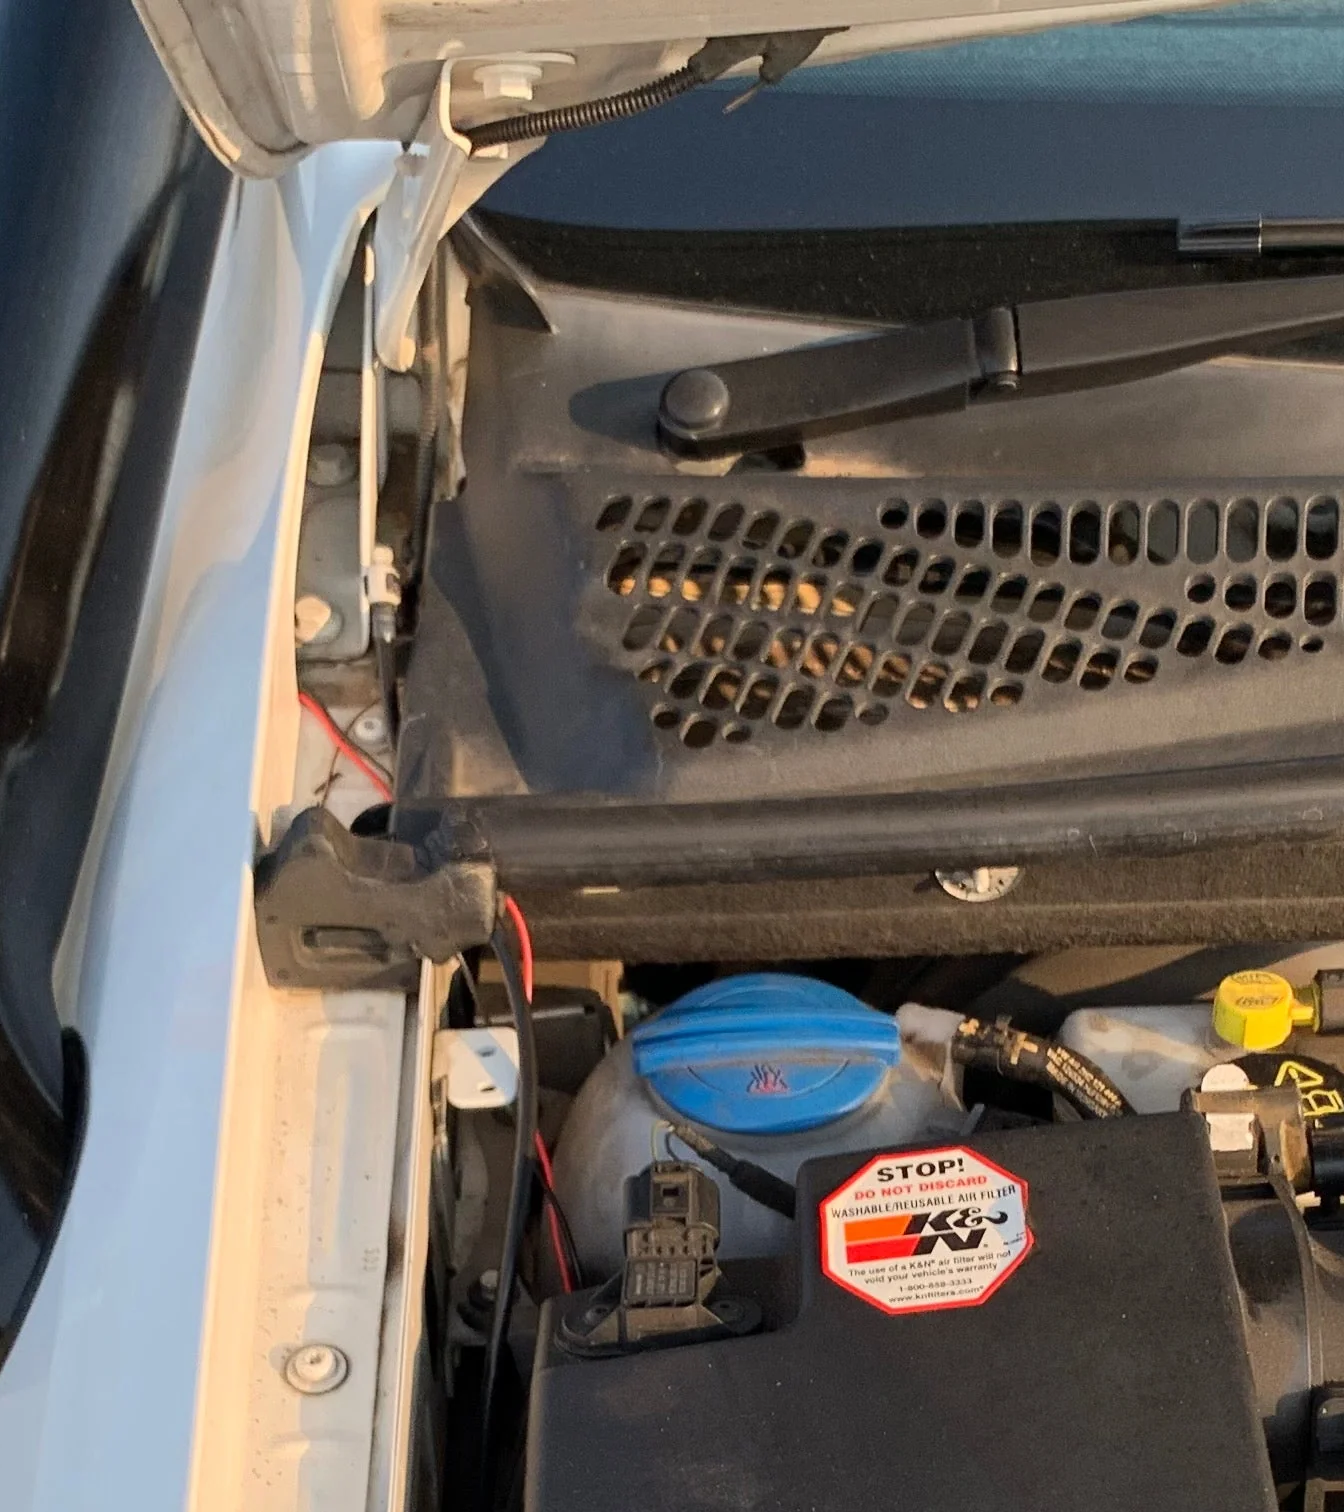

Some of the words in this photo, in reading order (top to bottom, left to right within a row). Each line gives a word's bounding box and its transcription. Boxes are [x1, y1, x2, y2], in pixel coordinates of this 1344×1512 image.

[877, 1158, 964, 1182] STOP!
[855, 1190, 876, 1200] DO
[881, 1184, 913, 1197] NOT
[919, 1175, 987, 1191] DISCARD
[958, 1191, 976, 1203] AIR
[981, 1184, 1016, 1200] FILTER
[849, 1269, 866, 1277] The
[889, 1264, 898, 1272] of
[938, 1258, 950, 1266] air
[953, 1255, 975, 1264] filter
[977, 1252, 994, 1261] will
[996, 1249, 1011, 1259] not
[864, 1275, 885, 1284] void
[887, 1273, 908, 1283] your
[912, 1266, 954, 1278] vehicle's
[956, 1262, 998, 1273] warranty
